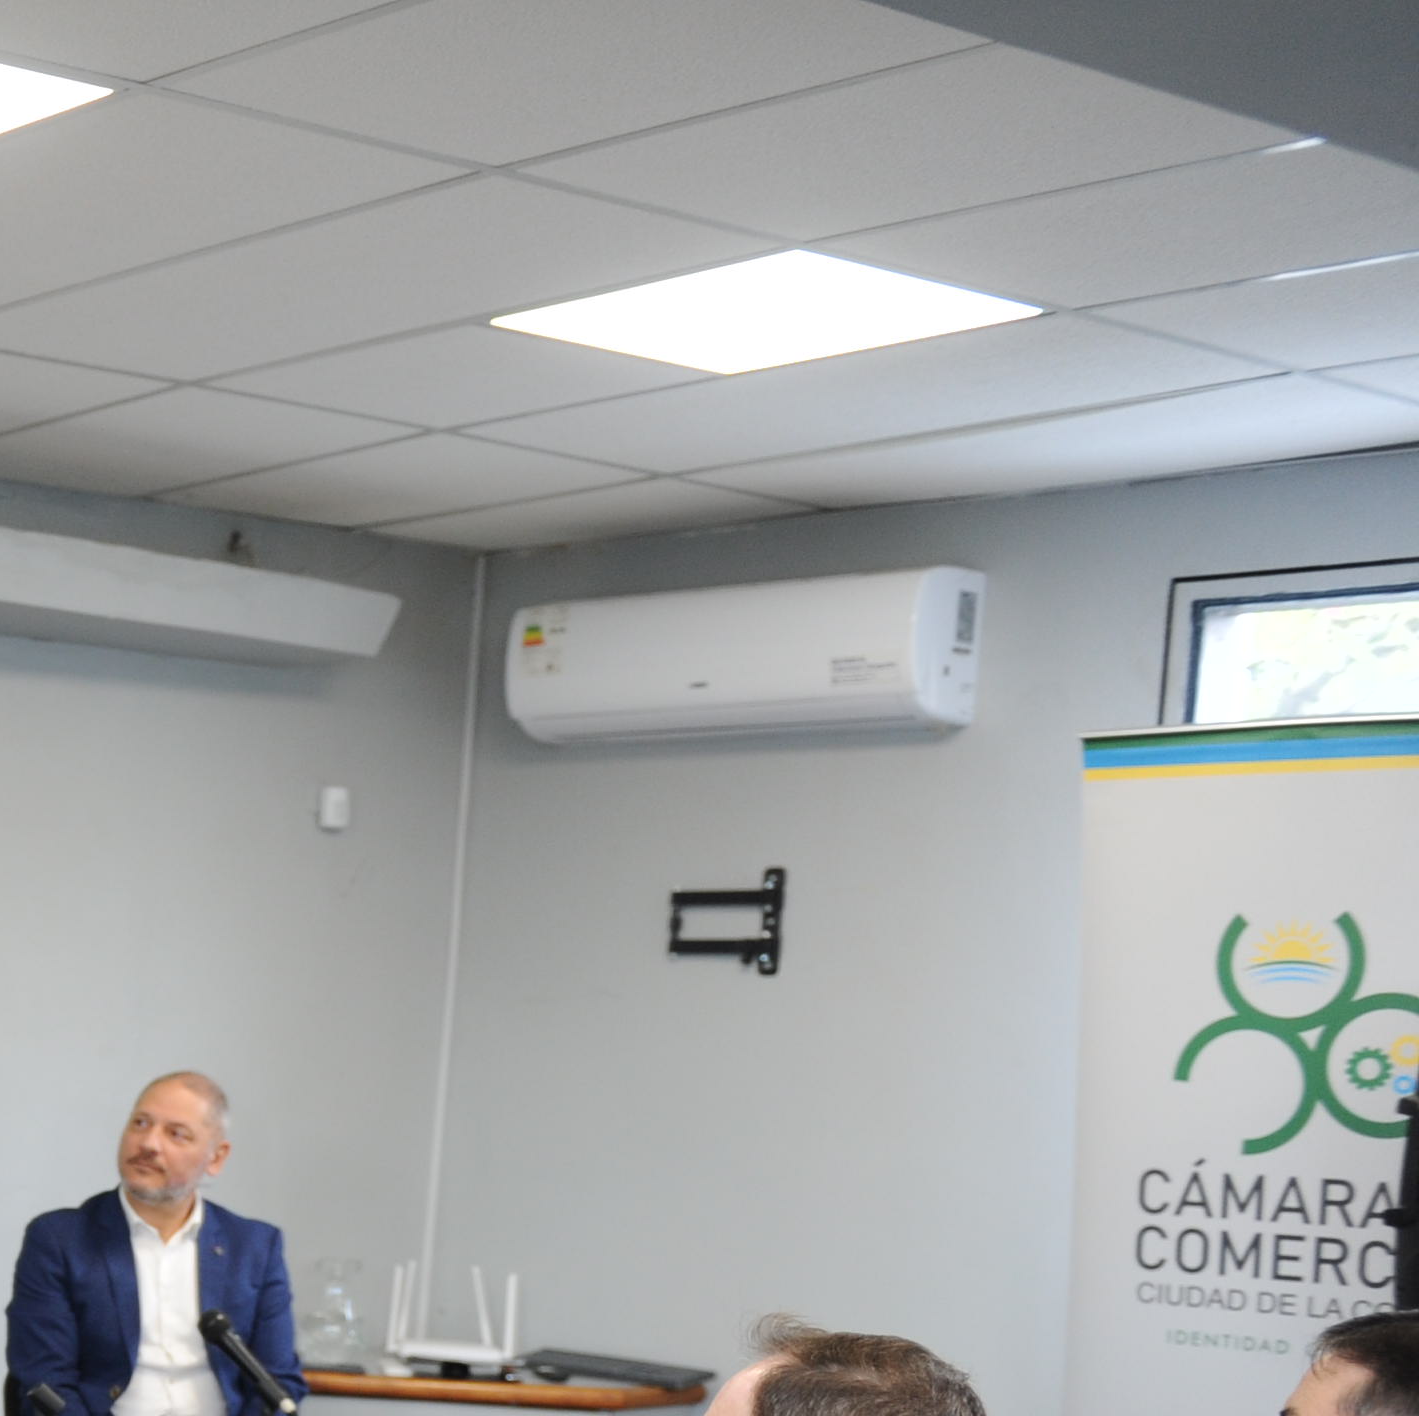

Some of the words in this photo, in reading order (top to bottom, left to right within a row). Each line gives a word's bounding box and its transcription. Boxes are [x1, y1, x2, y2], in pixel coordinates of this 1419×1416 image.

[1139, 1158, 1397, 1229] CÁMARA
[1137, 1281, 1247, 1311] CIUDAD
[1257, 1292, 1297, 1316] DE
[1307, 1296, 1343, 1319] LA
